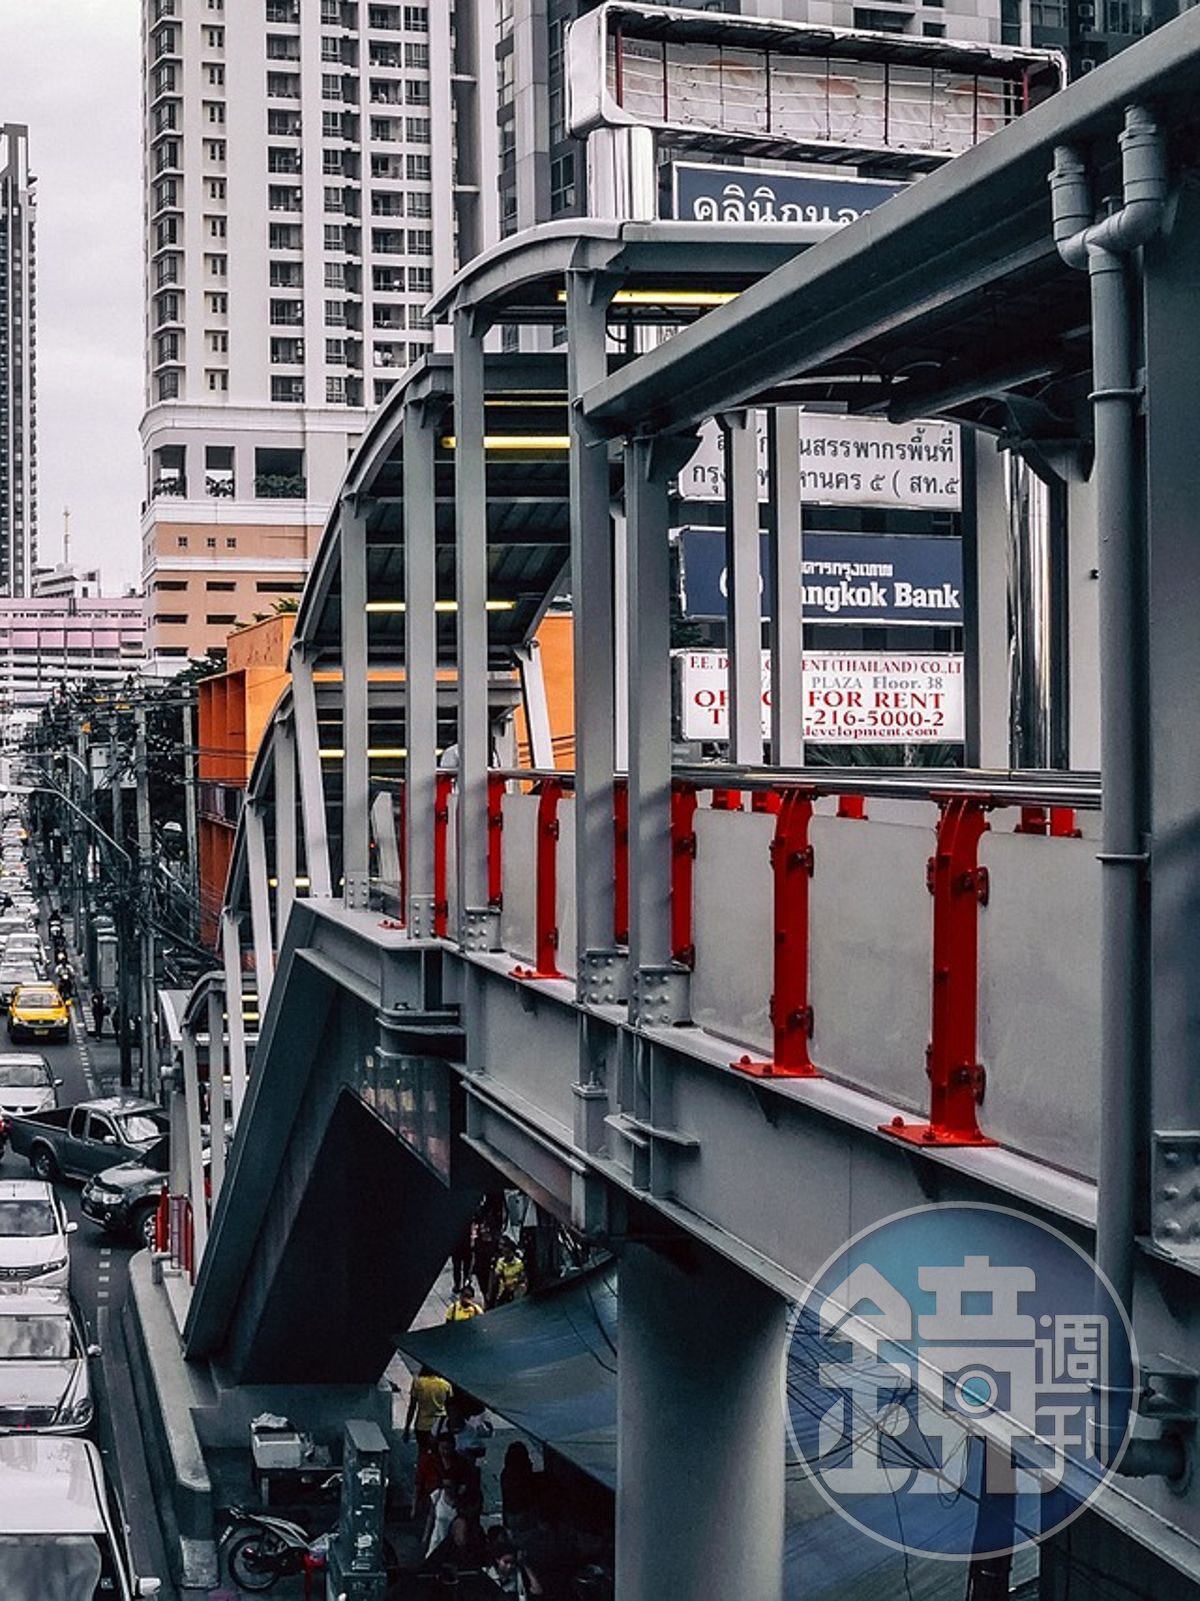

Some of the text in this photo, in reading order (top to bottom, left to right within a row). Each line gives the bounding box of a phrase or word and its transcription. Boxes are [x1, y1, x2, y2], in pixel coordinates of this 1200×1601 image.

[894, 582, 960, 608] Bank
[812, 677, 862, 689] PLAZA
[808, 691, 862, 708] FOR
[875, 692, 945, 709] RENT
